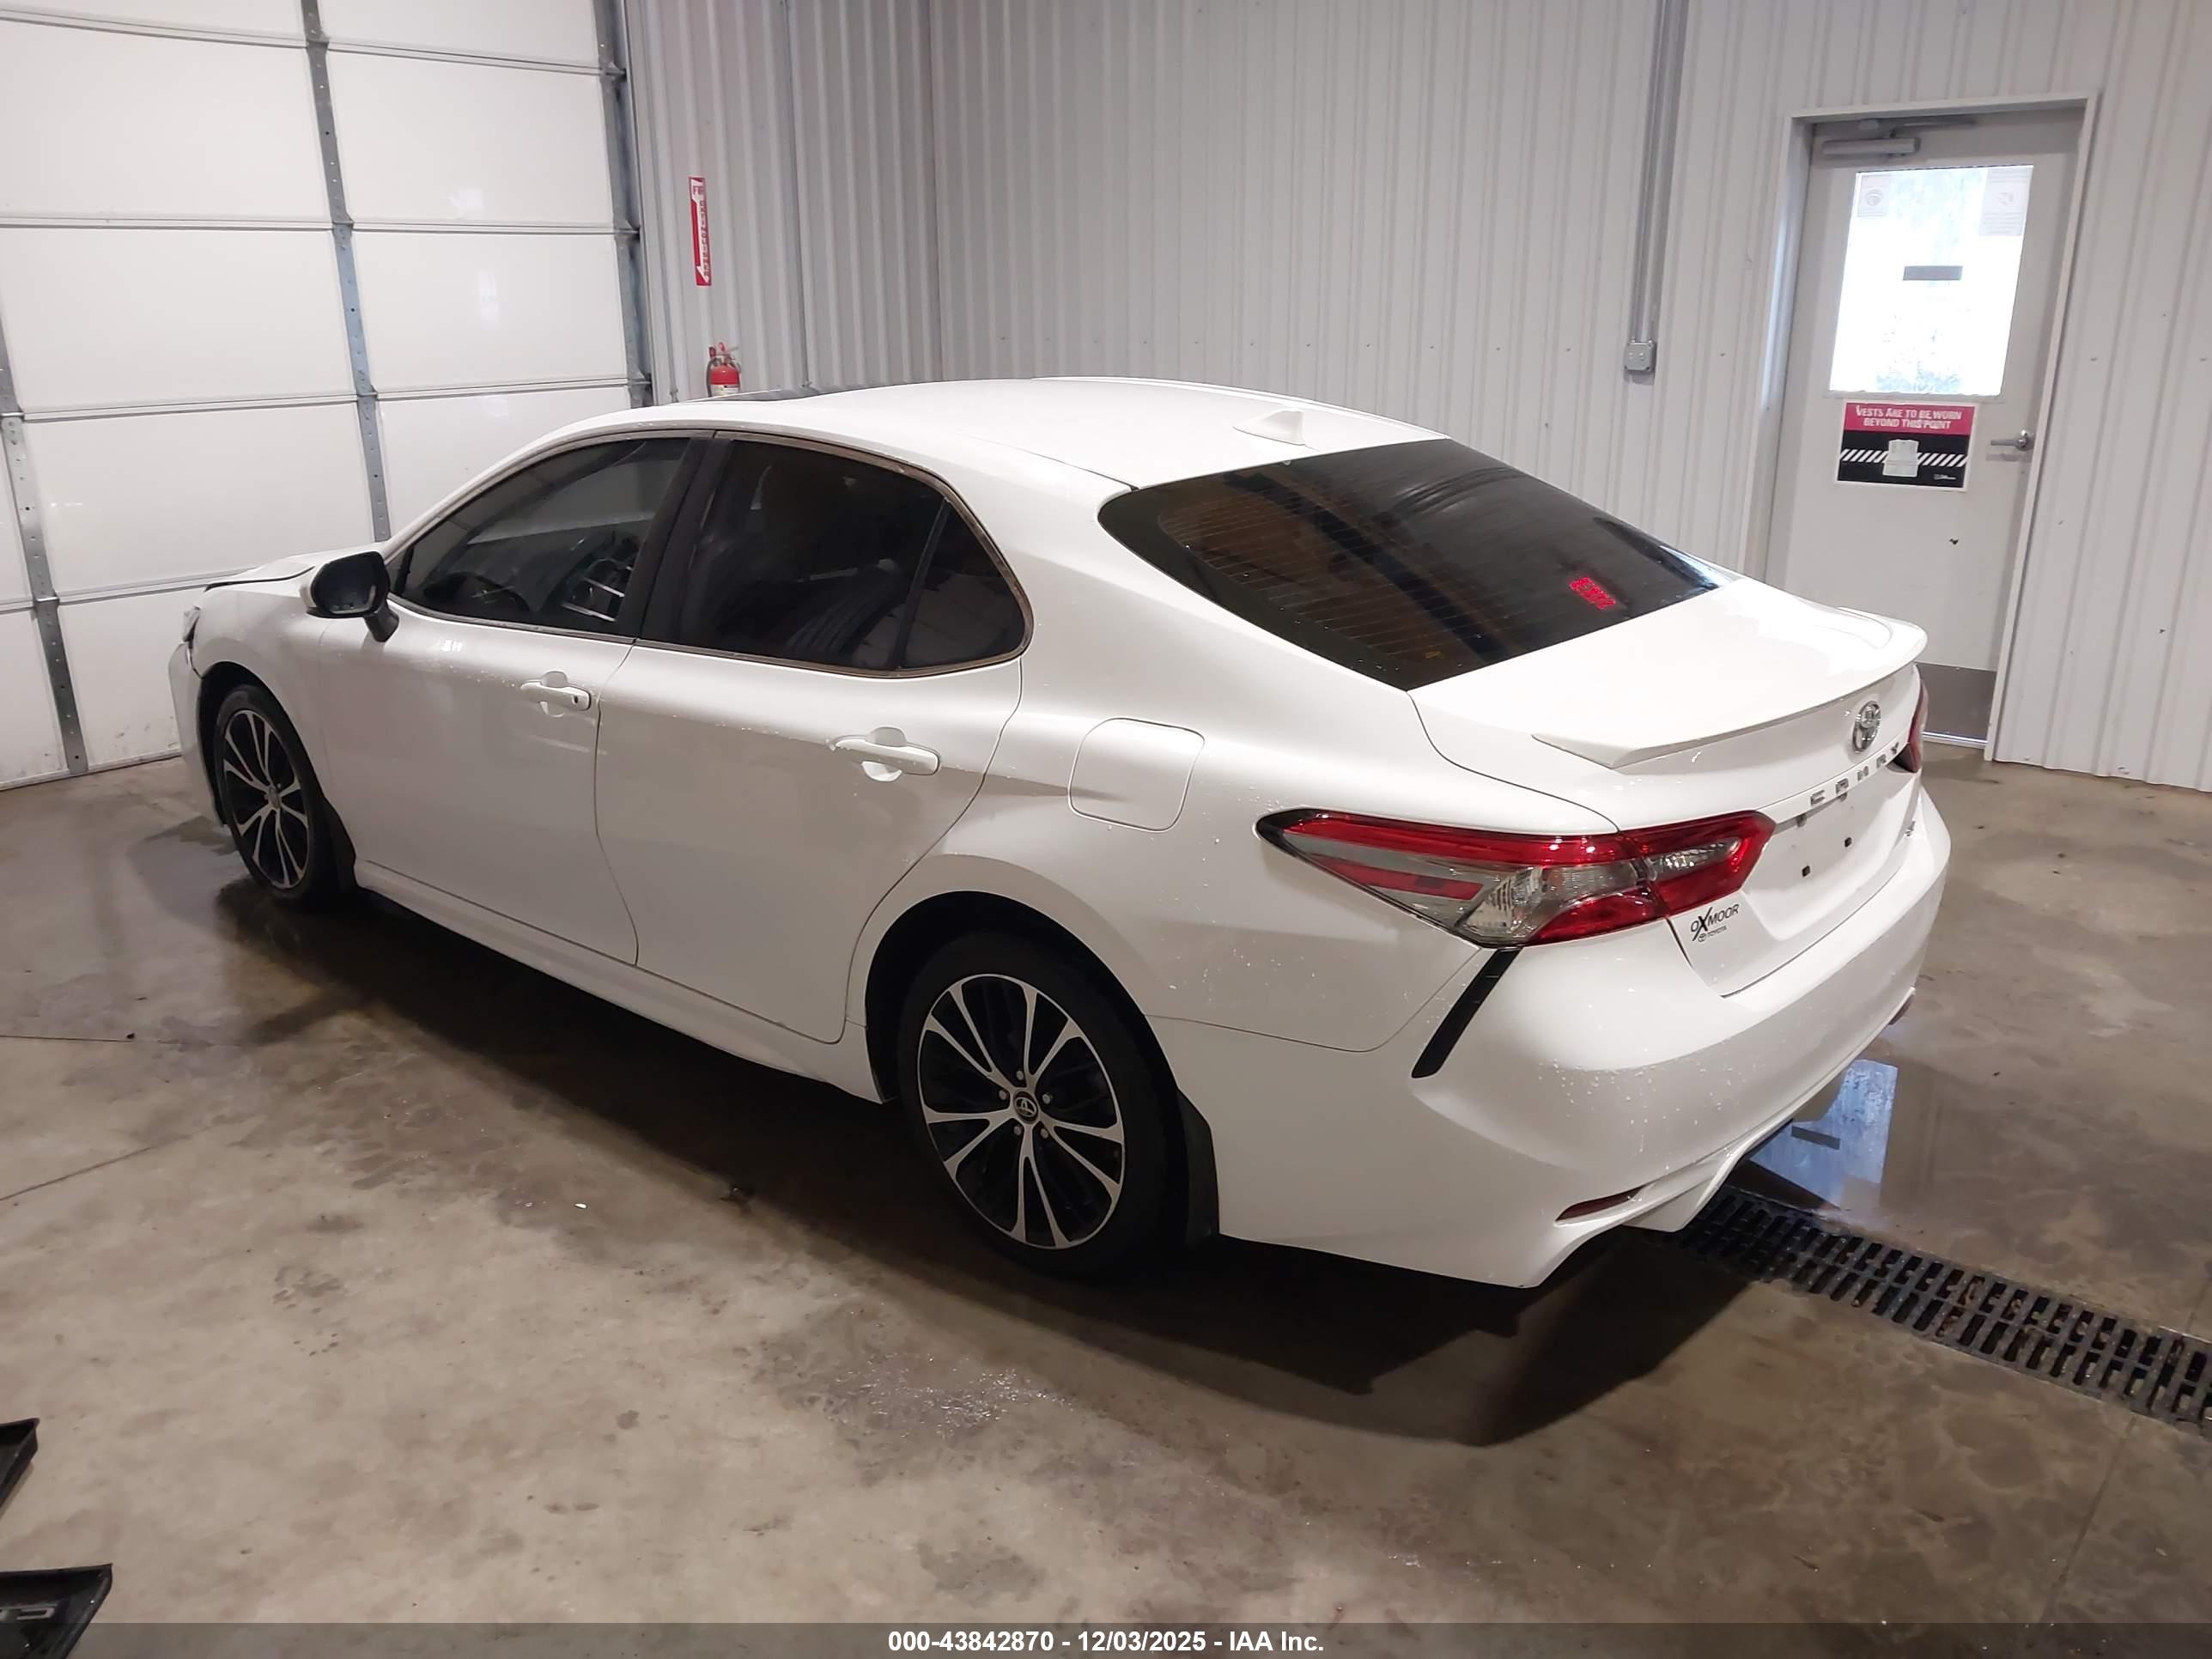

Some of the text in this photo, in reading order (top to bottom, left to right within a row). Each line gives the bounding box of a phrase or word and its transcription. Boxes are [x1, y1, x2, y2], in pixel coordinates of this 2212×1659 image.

[1856, 405, 1962, 420] VESTS ARE TO BE WORN
[1863, 417, 1951, 429] BEYOND THIS POINT
